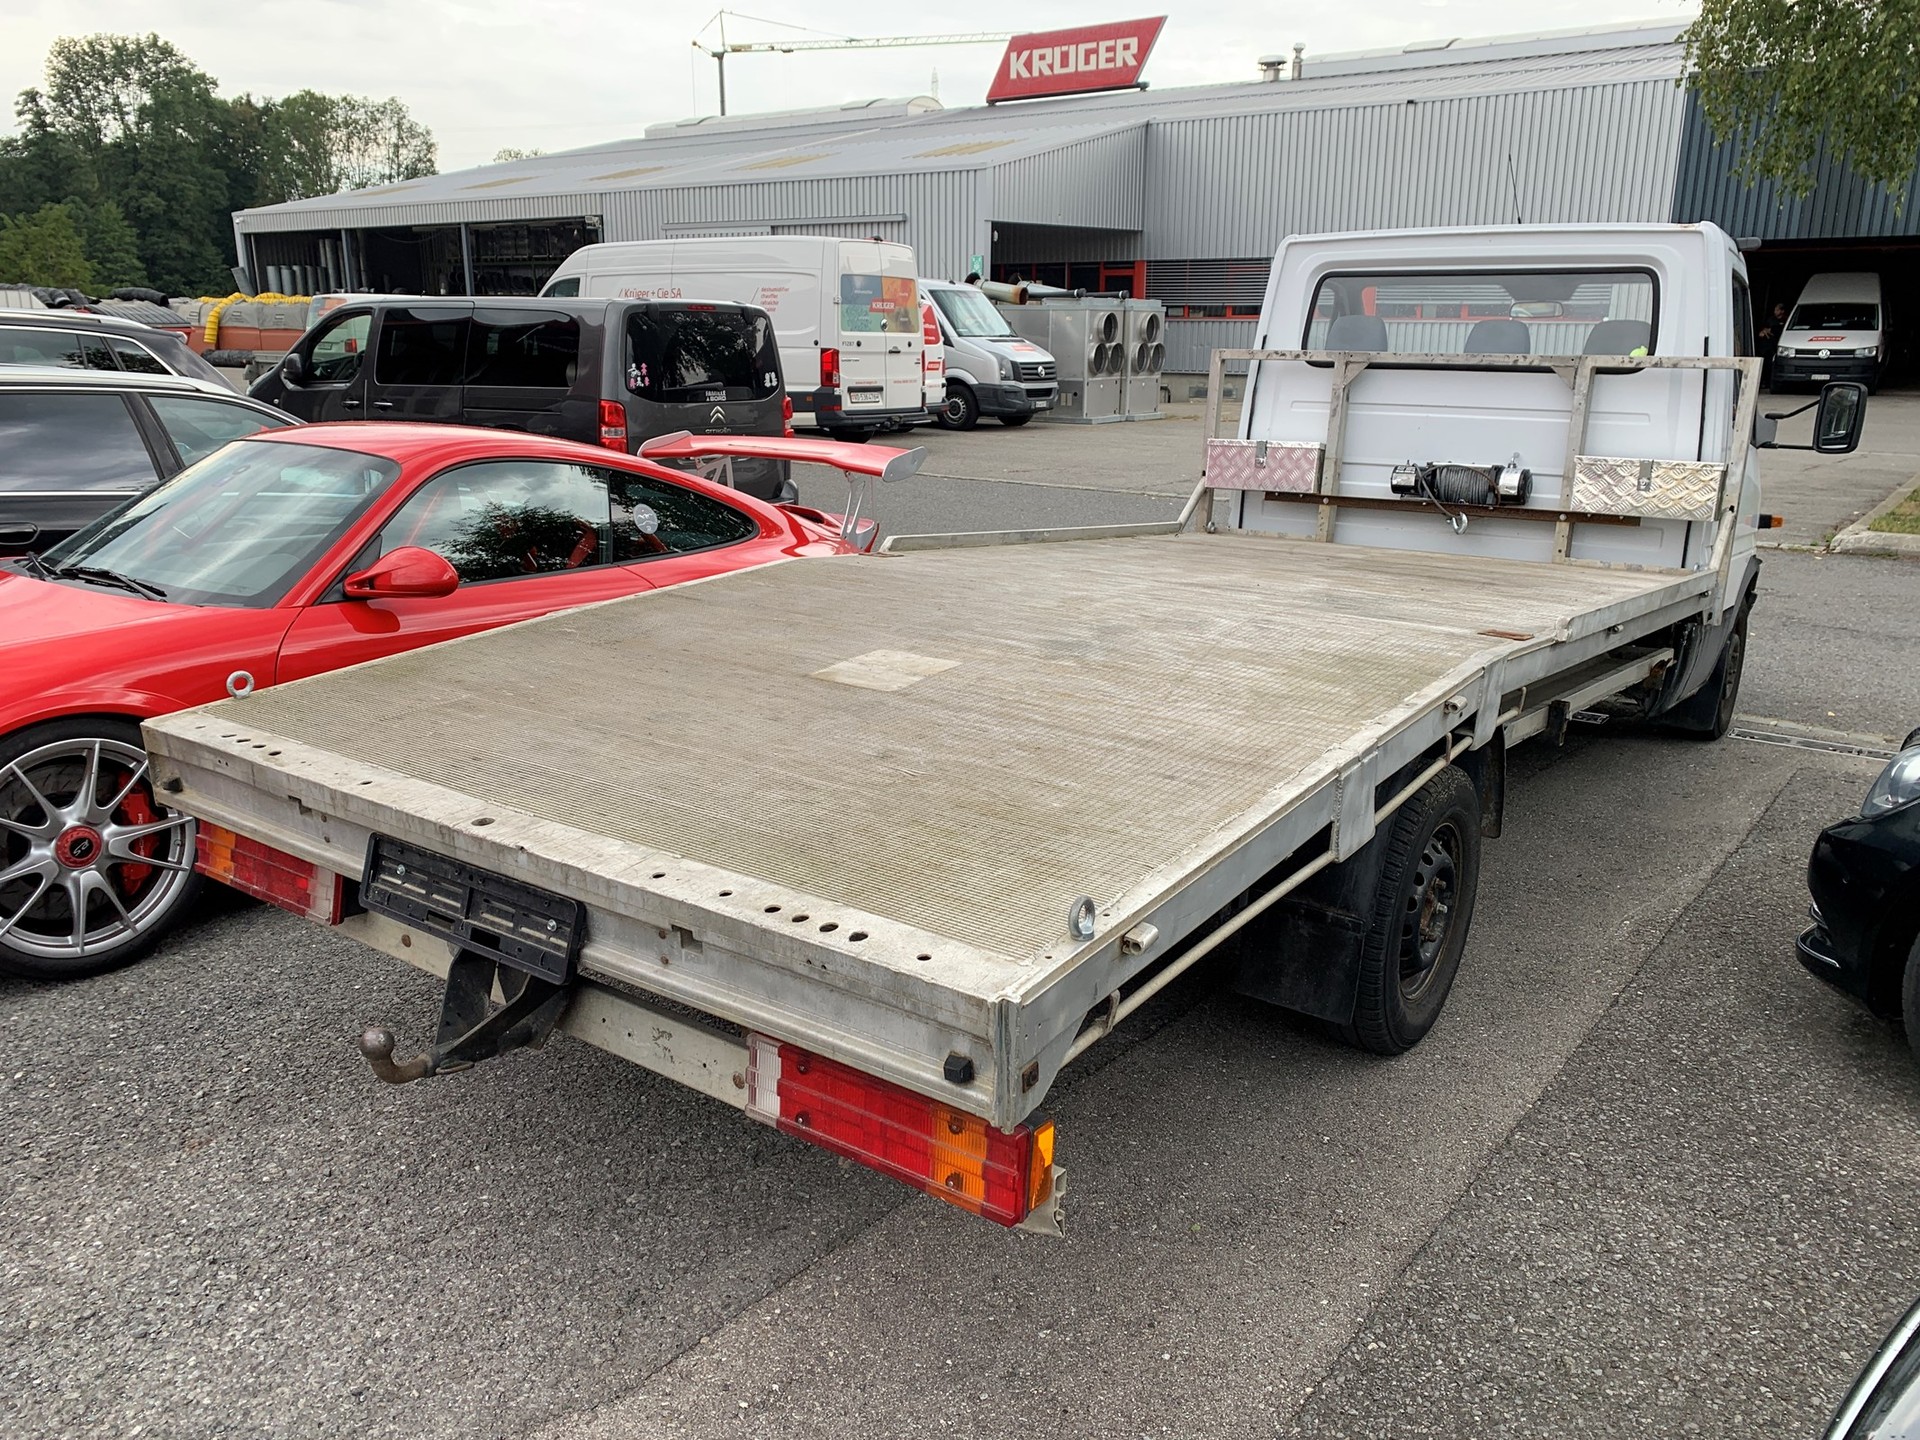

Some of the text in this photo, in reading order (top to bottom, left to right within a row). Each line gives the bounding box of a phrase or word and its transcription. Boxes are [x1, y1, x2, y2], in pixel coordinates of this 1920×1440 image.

[1009, 36, 1138, 80] KRÜGER
[657, 287, 669, 299] Cie
[671, 287, 682, 299] SA
